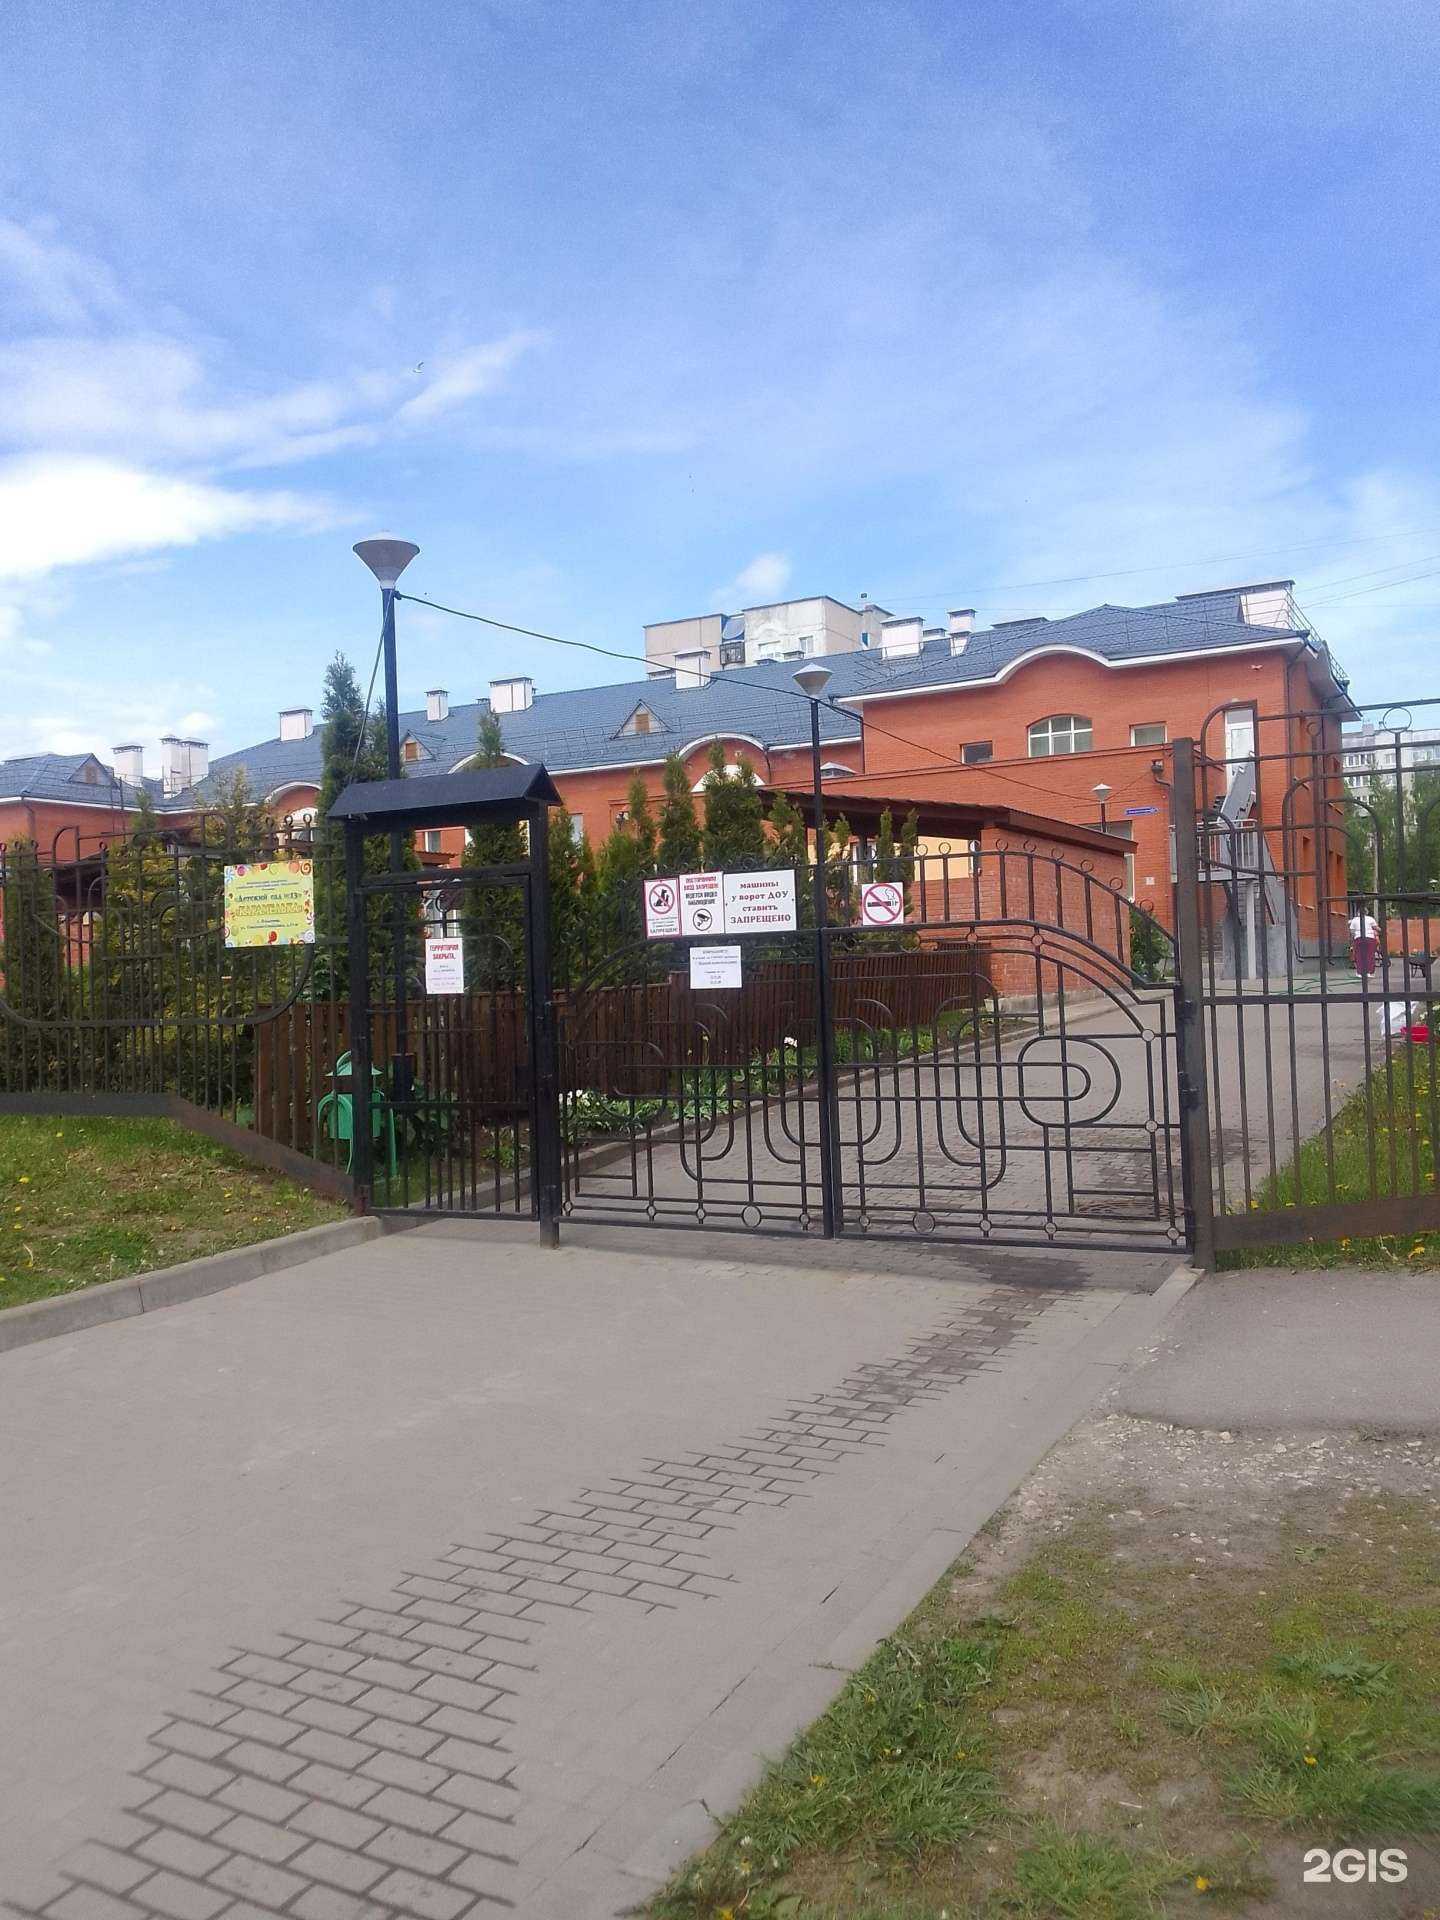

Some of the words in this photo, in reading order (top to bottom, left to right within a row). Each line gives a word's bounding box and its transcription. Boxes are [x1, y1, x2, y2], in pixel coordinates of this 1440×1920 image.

[740, 881, 779, 889] машины
[768, 890, 789, 900] ДОУ
[730, 914, 791, 924] ЗАПРЕЩЕНО
